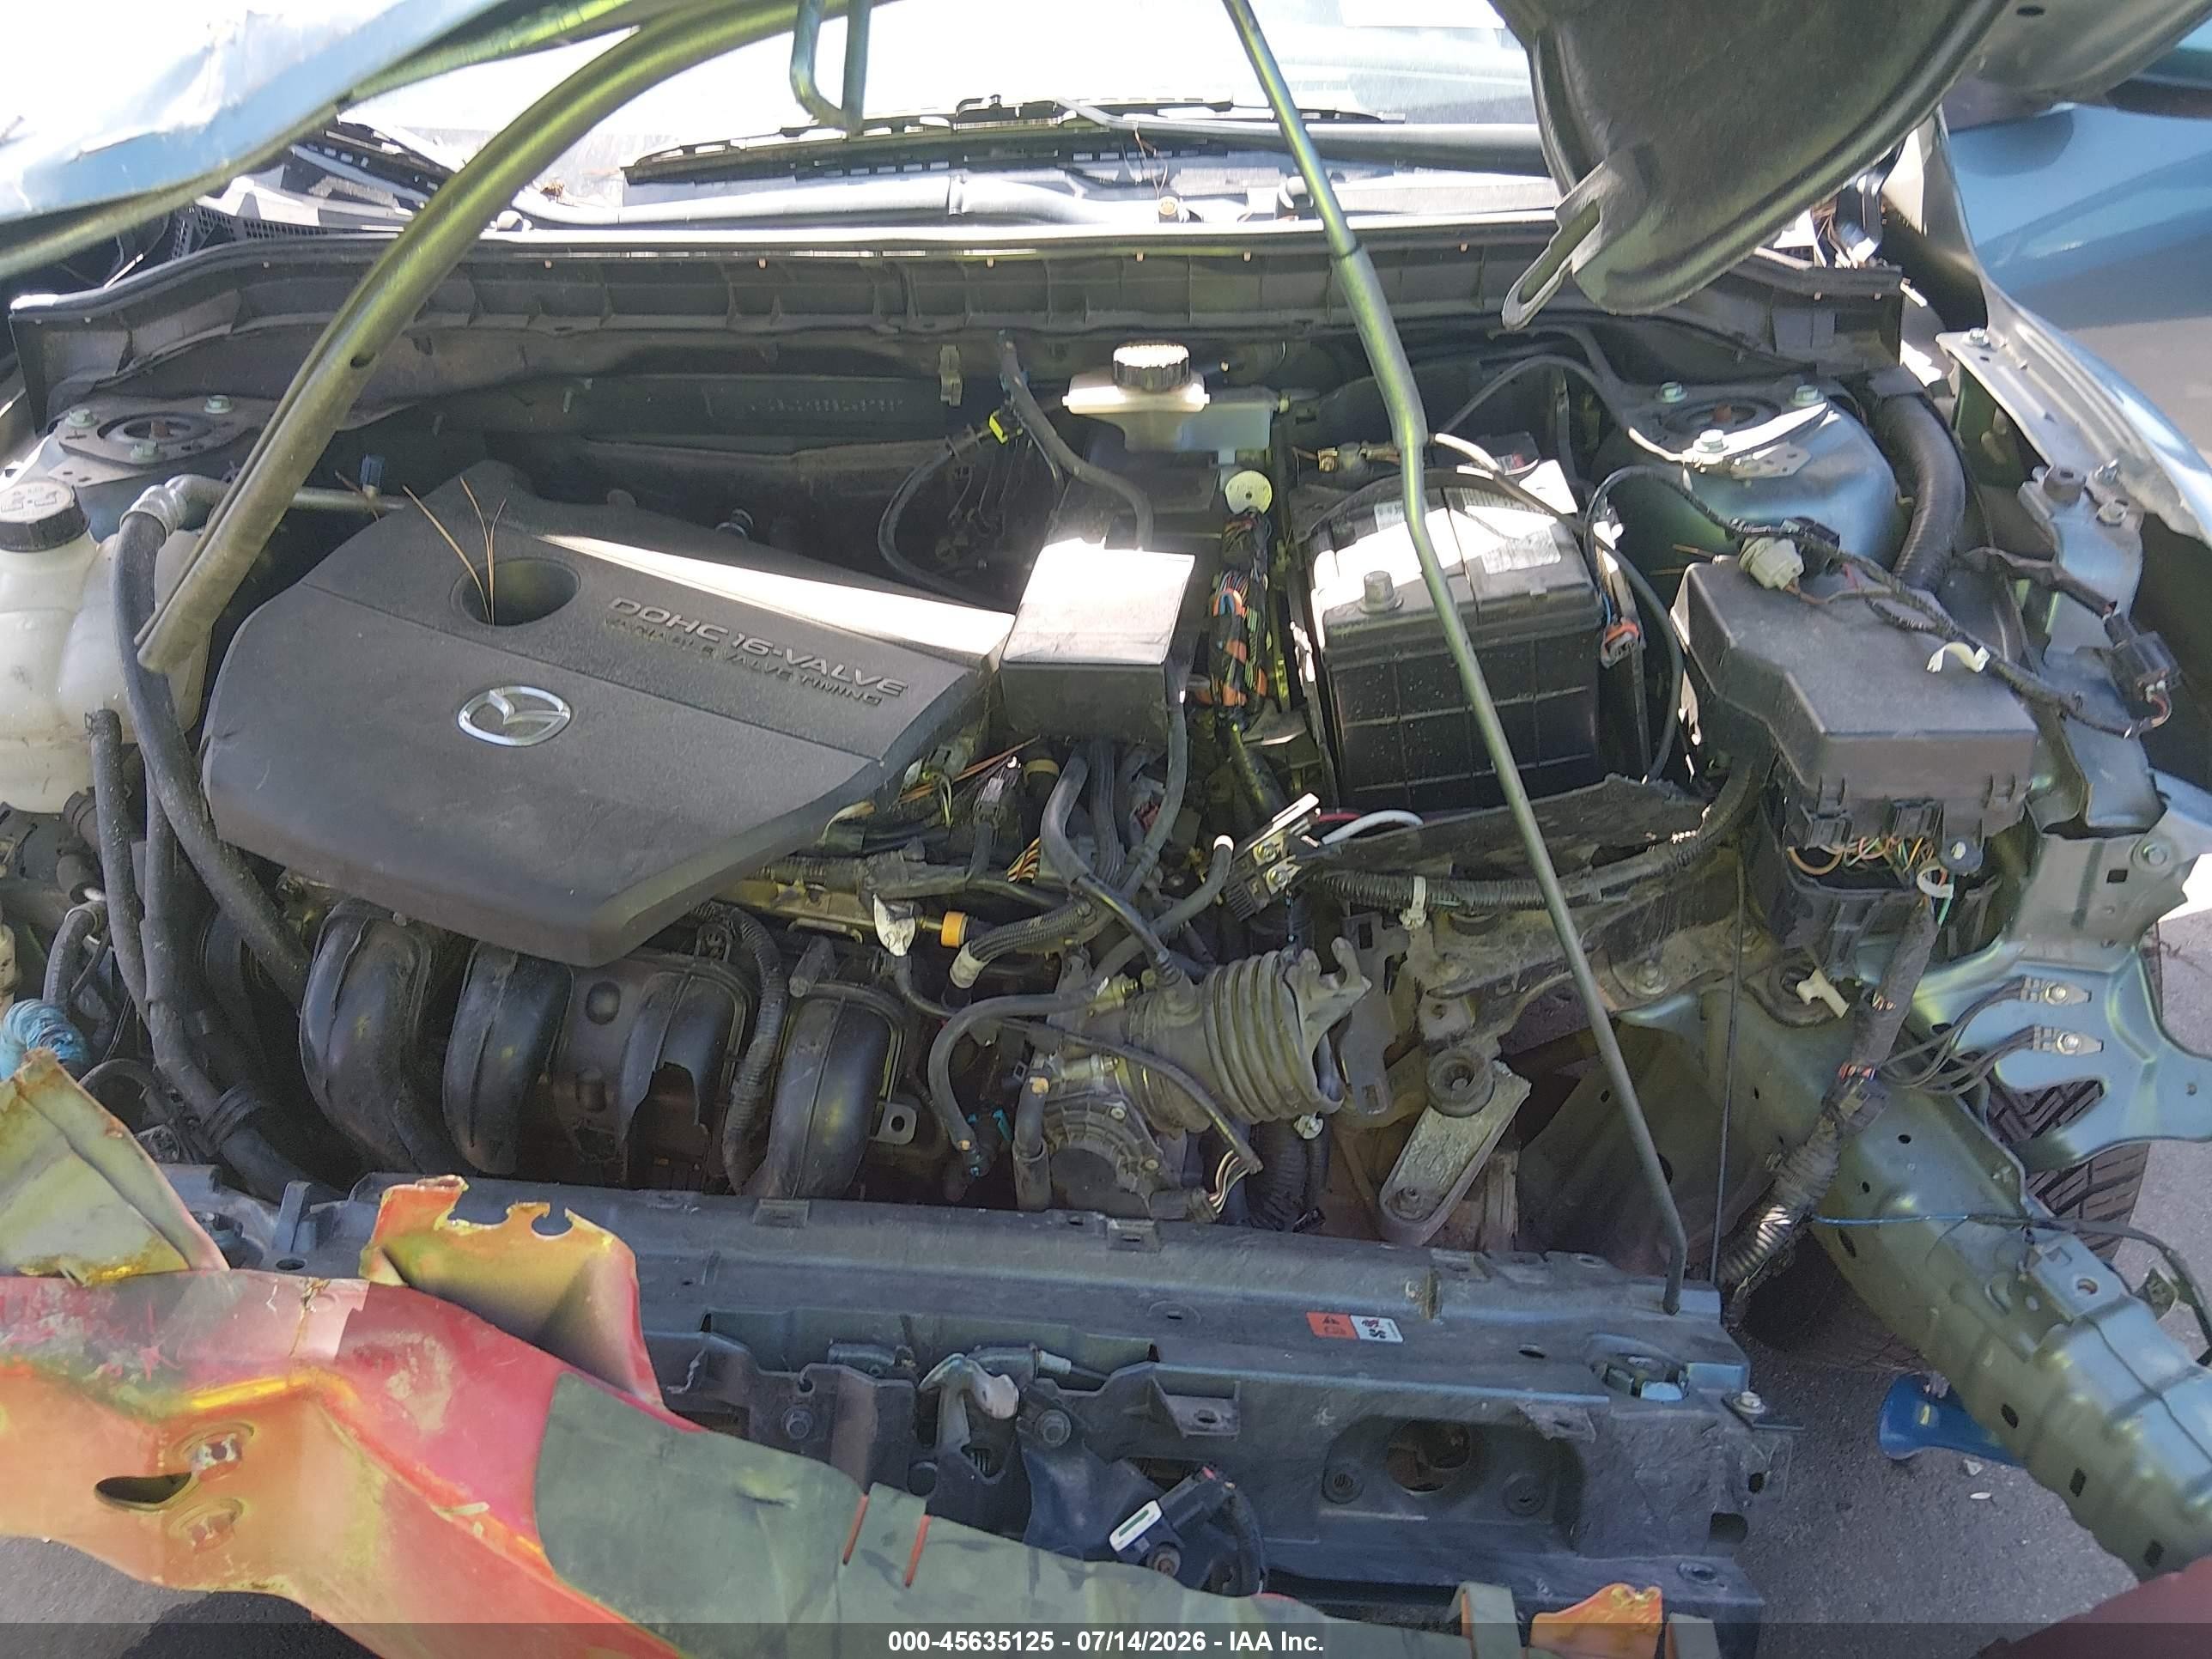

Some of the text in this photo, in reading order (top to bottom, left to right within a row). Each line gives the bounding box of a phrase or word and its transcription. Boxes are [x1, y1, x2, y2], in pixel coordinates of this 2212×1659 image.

[608, 597, 908, 696] DOHC 16-VALVE
[726, 653, 794, 682] VALVE
[800, 673, 883, 708] TIMING
